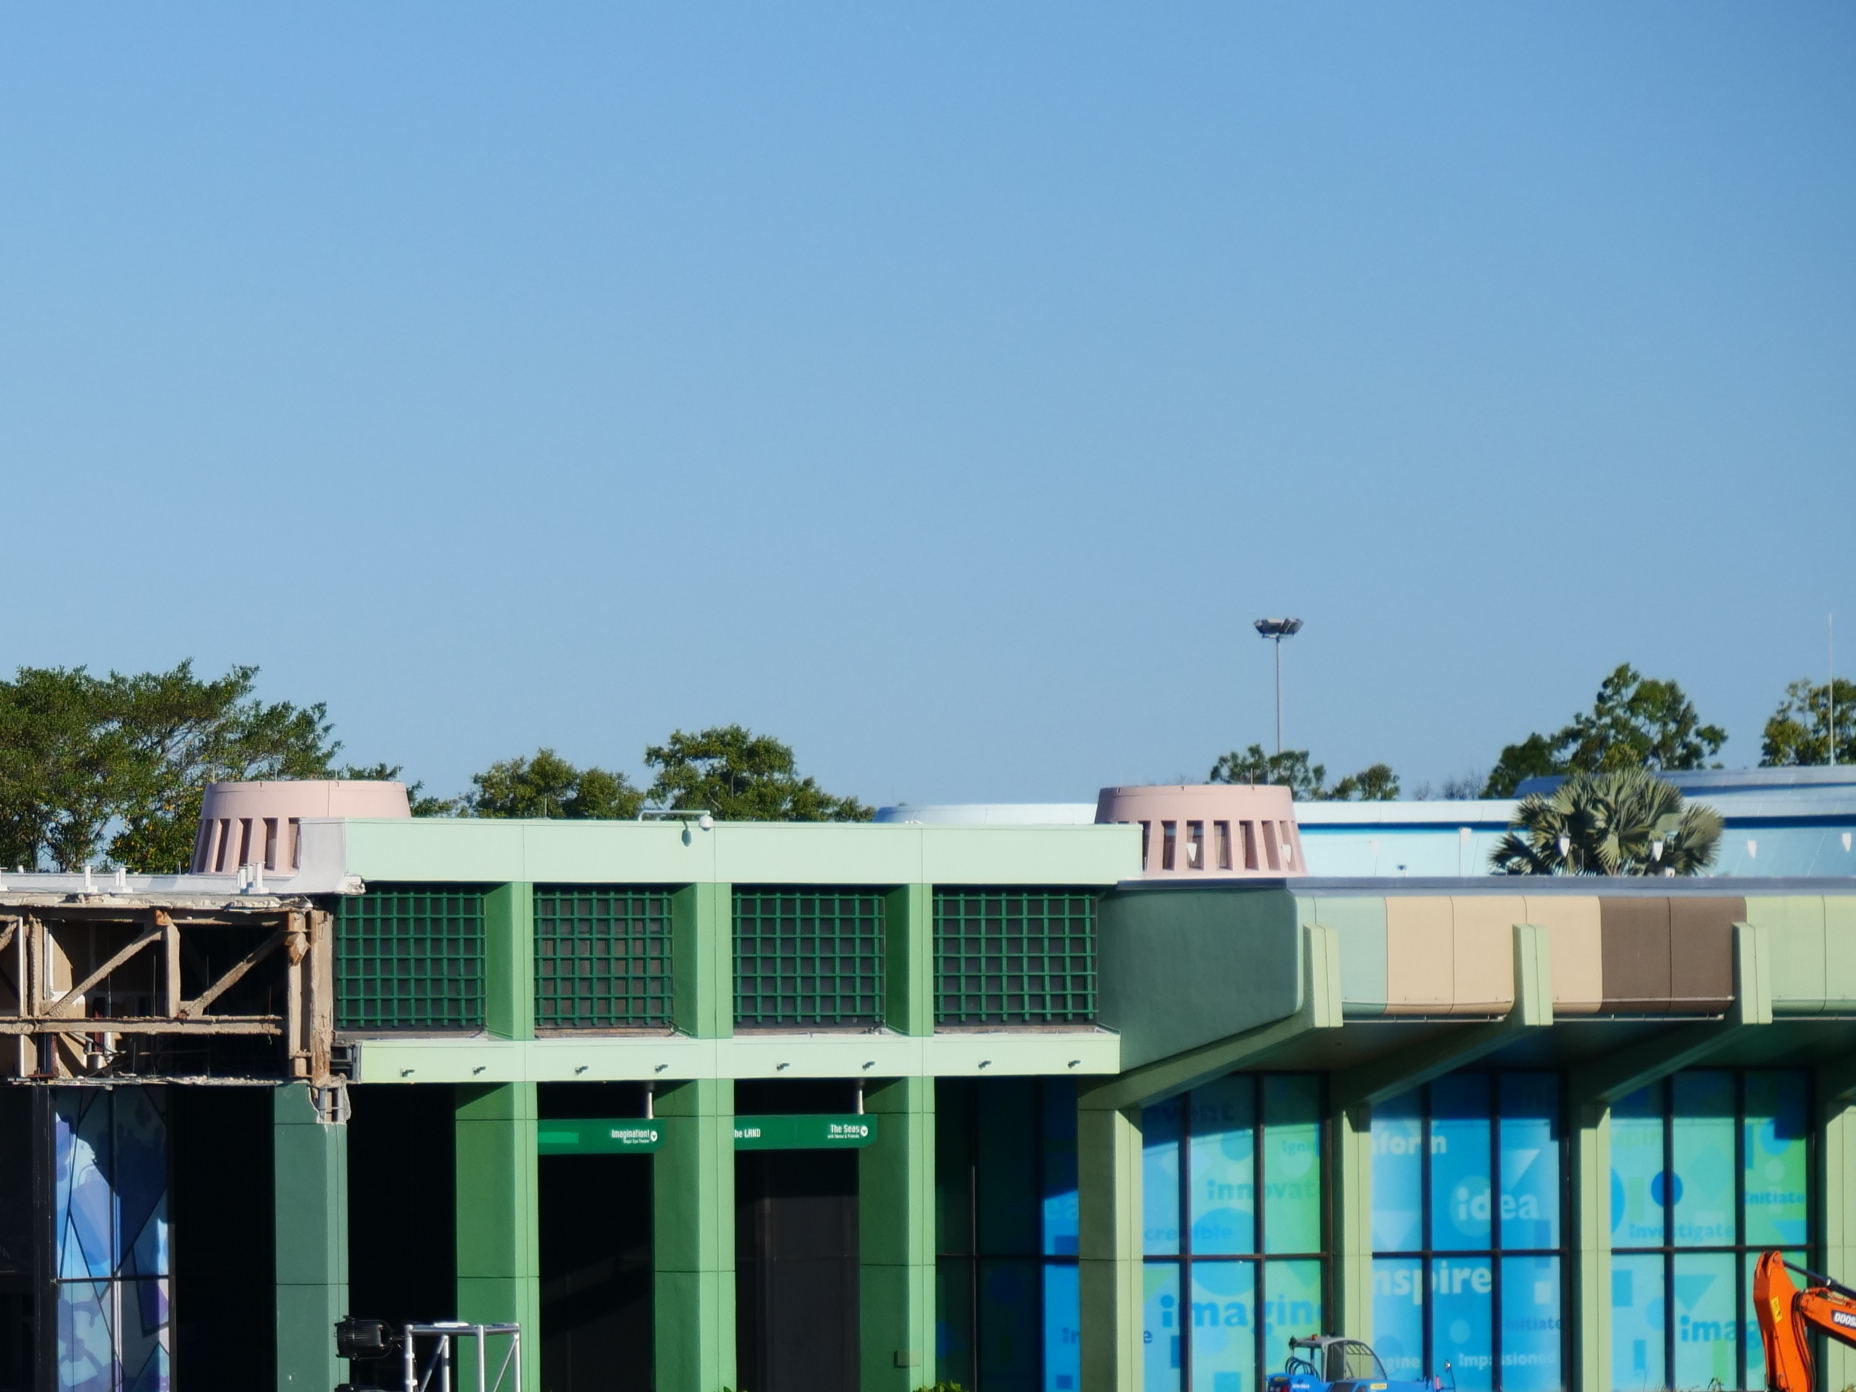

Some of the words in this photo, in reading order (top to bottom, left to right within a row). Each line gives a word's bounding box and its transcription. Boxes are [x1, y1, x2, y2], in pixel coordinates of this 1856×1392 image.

[744, 1128, 761, 1138] LAND
[830, 1124, 842, 1134] The
[843, 1124, 860, 1134] Seas
[611, 1129, 650, 1140] Imagination!
[1456, 1186, 1541, 1221] idea
